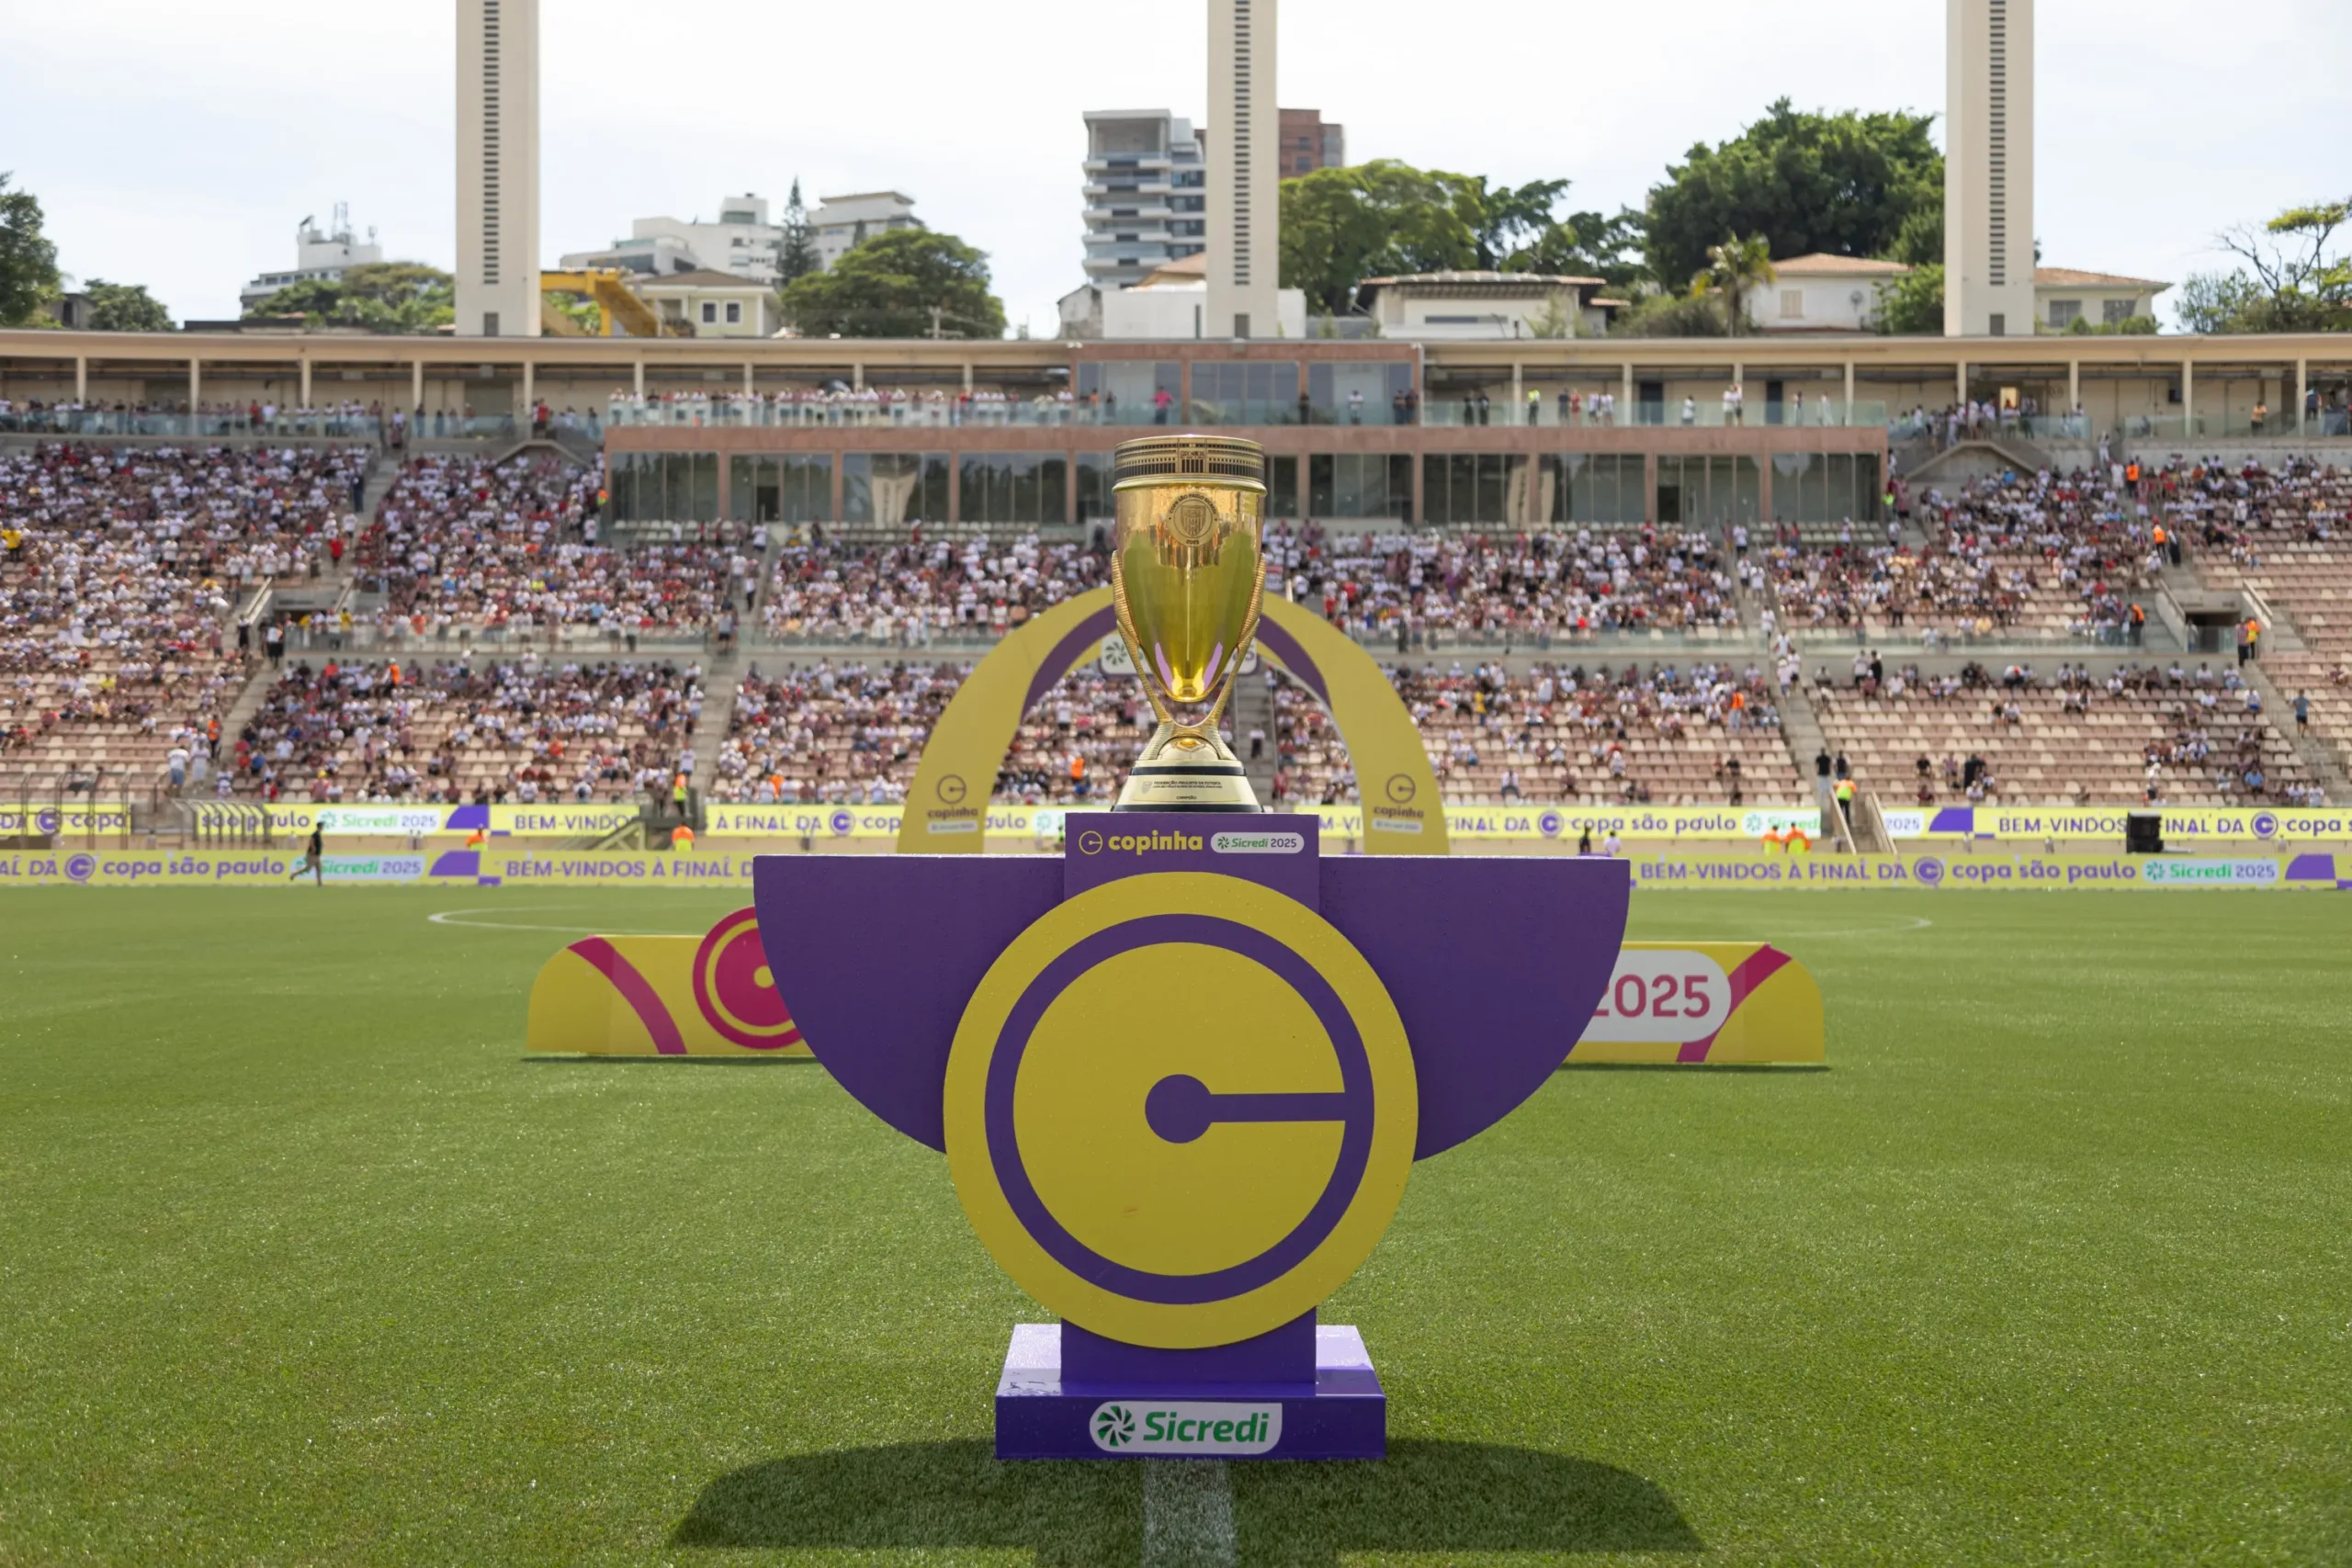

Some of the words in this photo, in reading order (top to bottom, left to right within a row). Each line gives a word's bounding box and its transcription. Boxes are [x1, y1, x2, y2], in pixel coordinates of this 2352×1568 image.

[401, 815, 438, 827] 2025
[736, 815, 790, 829] FINAL
[797, 816, 822, 829] DA
[863, 814, 902, 834] cop
[1505, 817, 1530, 832] DA
[1572, 817, 1624, 834] copa
[1632, 814, 1668, 830] são
[1676, 814, 1736, 834] paulo
[2165, 818, 2210, 834] INAL
[2217, 818, 2245, 833] DA
[2286, 818, 2342, 837] copa
[1108, 829, 1203, 856] copinha
[1231, 837, 1269, 849] Sicredi
[1271, 838, 1297, 849] 2025
[103, 861, 162, 879] copa
[169, 856, 210, 875] são
[216, 856, 285, 879] paulo
[382, 861, 422, 874] 2025
[506, 860, 646, 877] BEM-VINDOS
[673, 860, 733, 877] FINAL
[1640, 862, 1781, 880] BEM-VINDOS
[1809, 862, 1871, 880] FINAL
[1878, 862, 1908, 880] DA
[1952, 864, 2012, 884] copa
[2019, 860, 2061, 879] são
[2067, 860, 2137, 884] paulo
[2169, 863, 2233, 879] Sicredi
[2234, 863, 2277, 879] 2025
[1143, 1412, 1269, 1442] Sicredi
